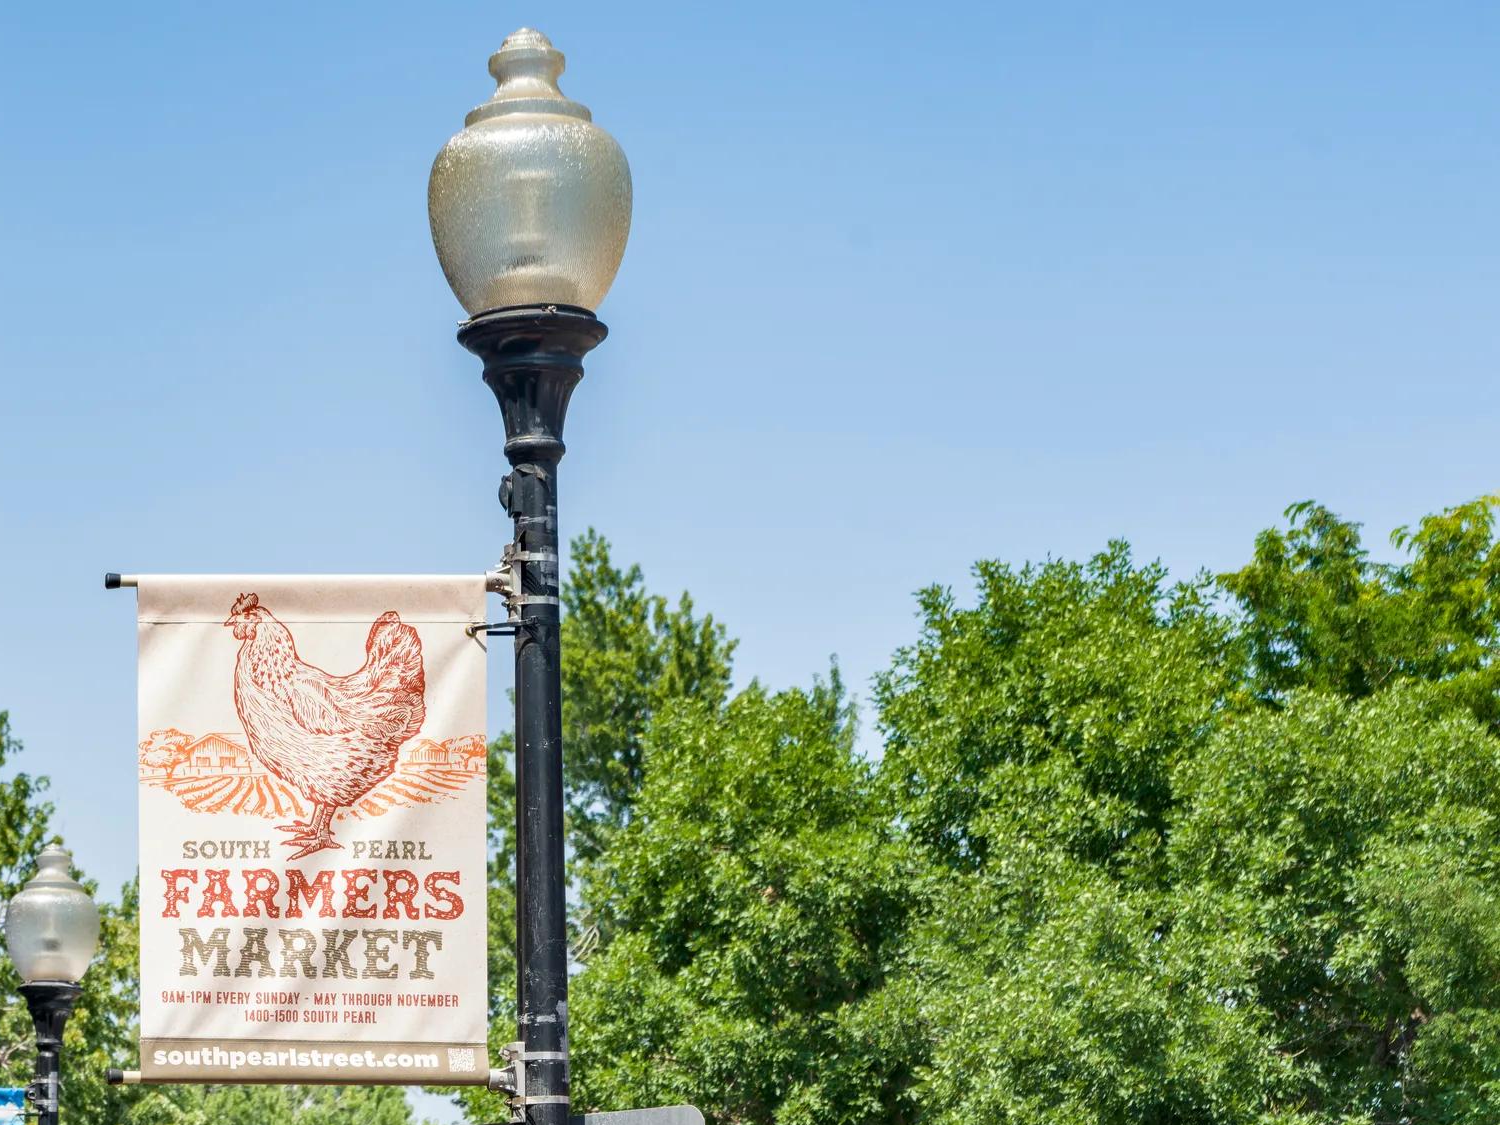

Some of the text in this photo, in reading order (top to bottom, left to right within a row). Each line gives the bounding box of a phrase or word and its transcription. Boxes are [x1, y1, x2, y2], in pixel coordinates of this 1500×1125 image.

[182, 839, 433, 860] SOUTH PEARL
[160, 868, 465, 921] FARMERS
[178, 927, 444, 980] MARKET
[161, 990, 212, 1004] 9AM-1PM
[216, 991, 251, 1005] EVERY
[255, 991, 301, 1005] SUNDAY
[313, 992, 337, 1006] MAY
[342, 992, 393, 1006] THROUGH
[397, 993, 459, 1007] NOVEMBER
[244, 1009, 378, 1024] 1400-1500 SOUTH PEARL
[153, 1046, 440, 1070] southpearlstreet.com
